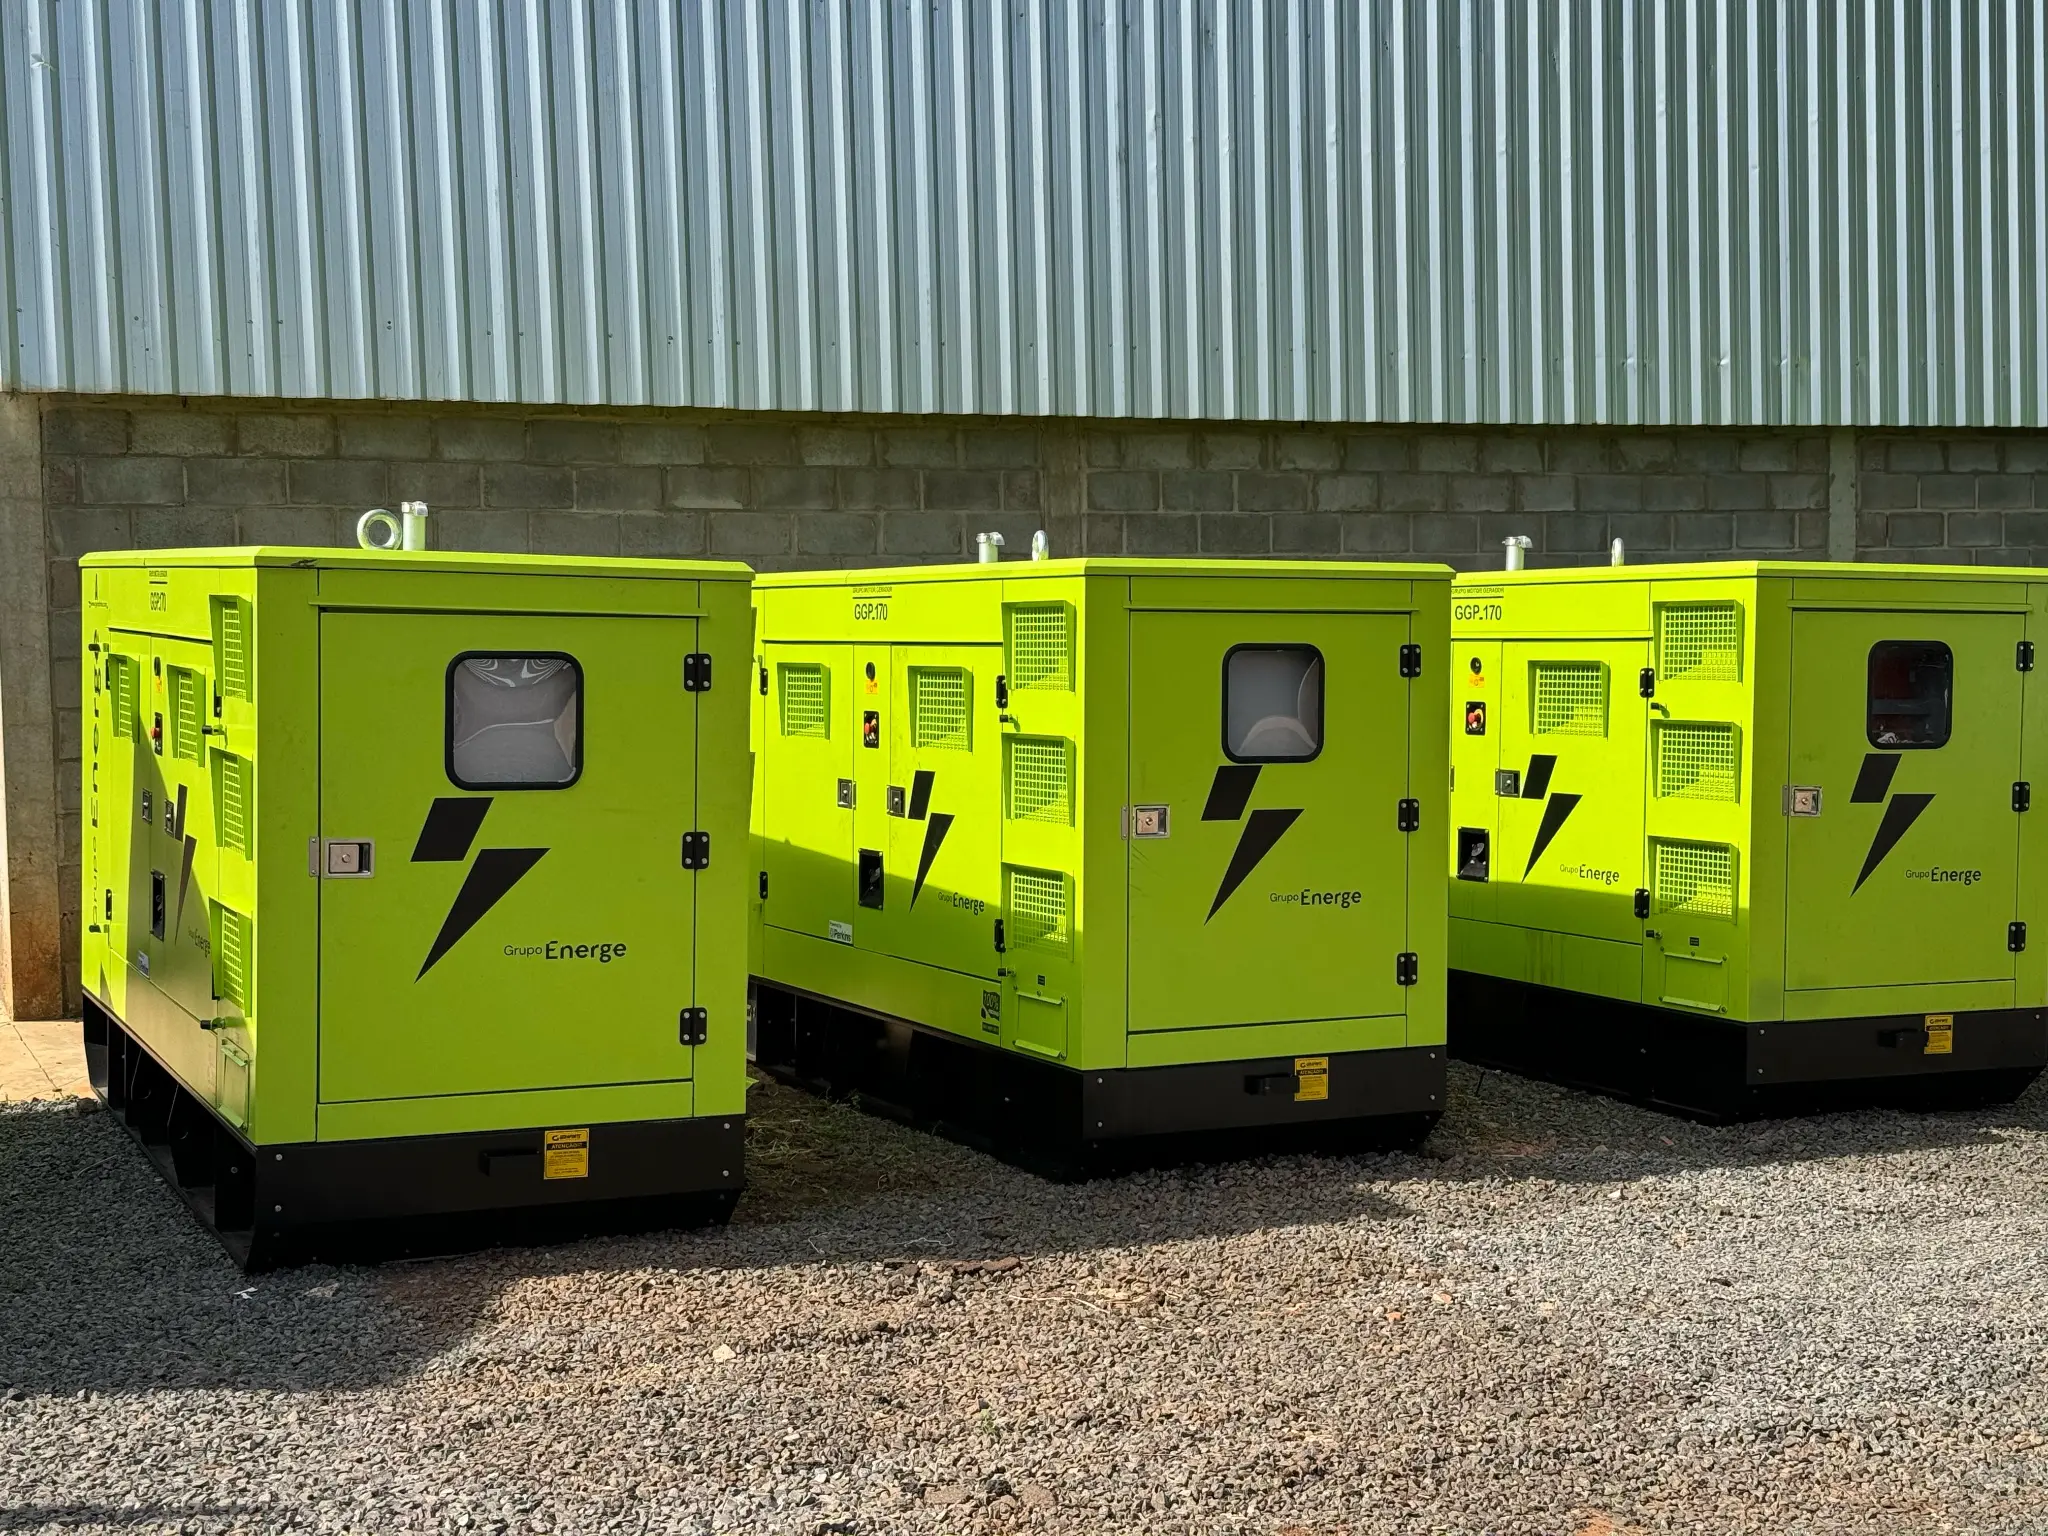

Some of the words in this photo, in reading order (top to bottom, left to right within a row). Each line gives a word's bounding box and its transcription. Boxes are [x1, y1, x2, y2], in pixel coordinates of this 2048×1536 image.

[854, 603, 888, 620] GGP.170
[1454, 604, 1502, 621] GGP.170
[1579, 864, 1620, 885] Energe
[1905, 869, 1930, 880] Grupo
[1931, 867, 1982, 886] Energe
[952, 892, 985, 915] Energe
[1269, 892, 1299, 904] Grupo
[1300, 888, 1362, 908] Energe
[503, 944, 543, 958] Grupo
[545, 940, 627, 963] Energe
